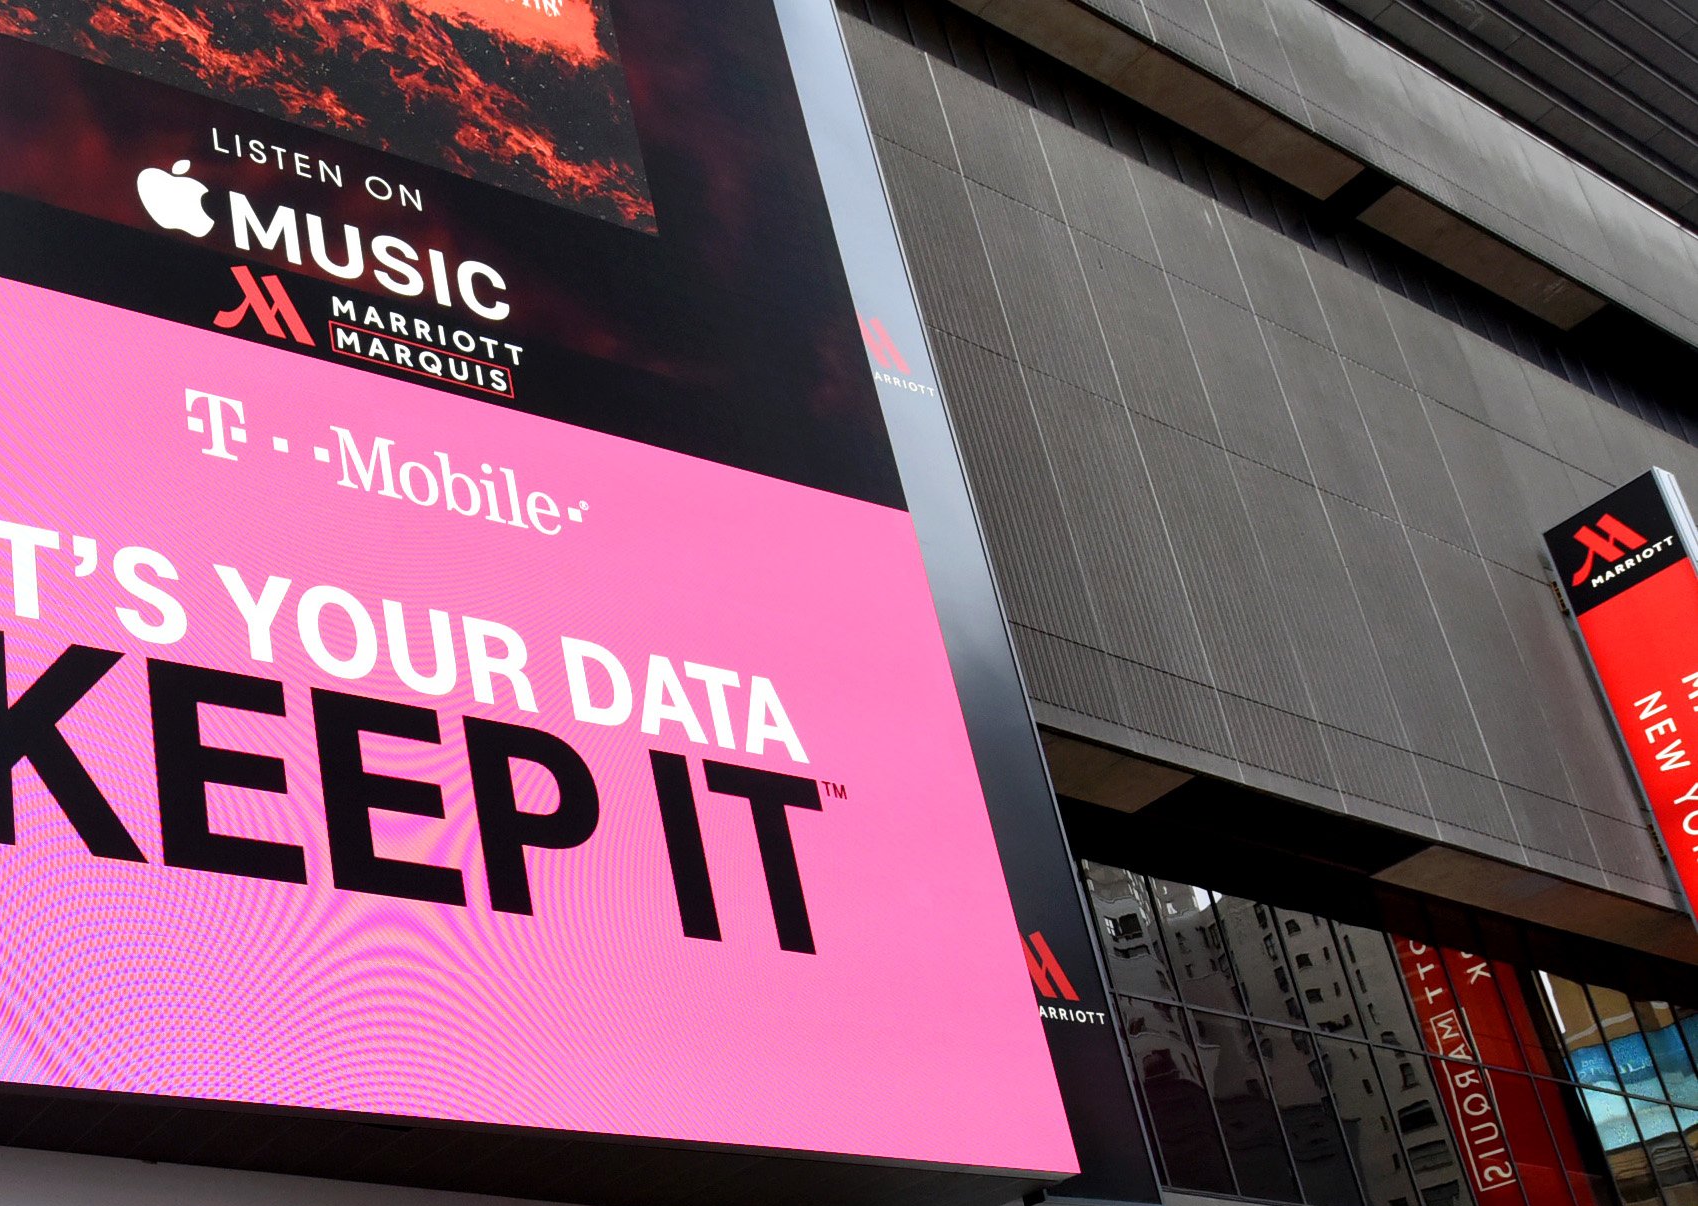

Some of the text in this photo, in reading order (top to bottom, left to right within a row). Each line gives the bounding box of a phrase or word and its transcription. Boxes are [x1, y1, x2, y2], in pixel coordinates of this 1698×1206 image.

[212, 126, 423, 212] LISTEN ON
[228, 190, 511, 321] MUSIC
[331, 295, 523, 367] MARRIOTT
[335, 327, 508, 393] MARQUIS
[1591, 535, 1675, 588] MARRIOTT
[215, 564, 539, 713] YOUR
[561, 635, 810, 764] DATA
[1633, 690, 1691, 772] NEW
